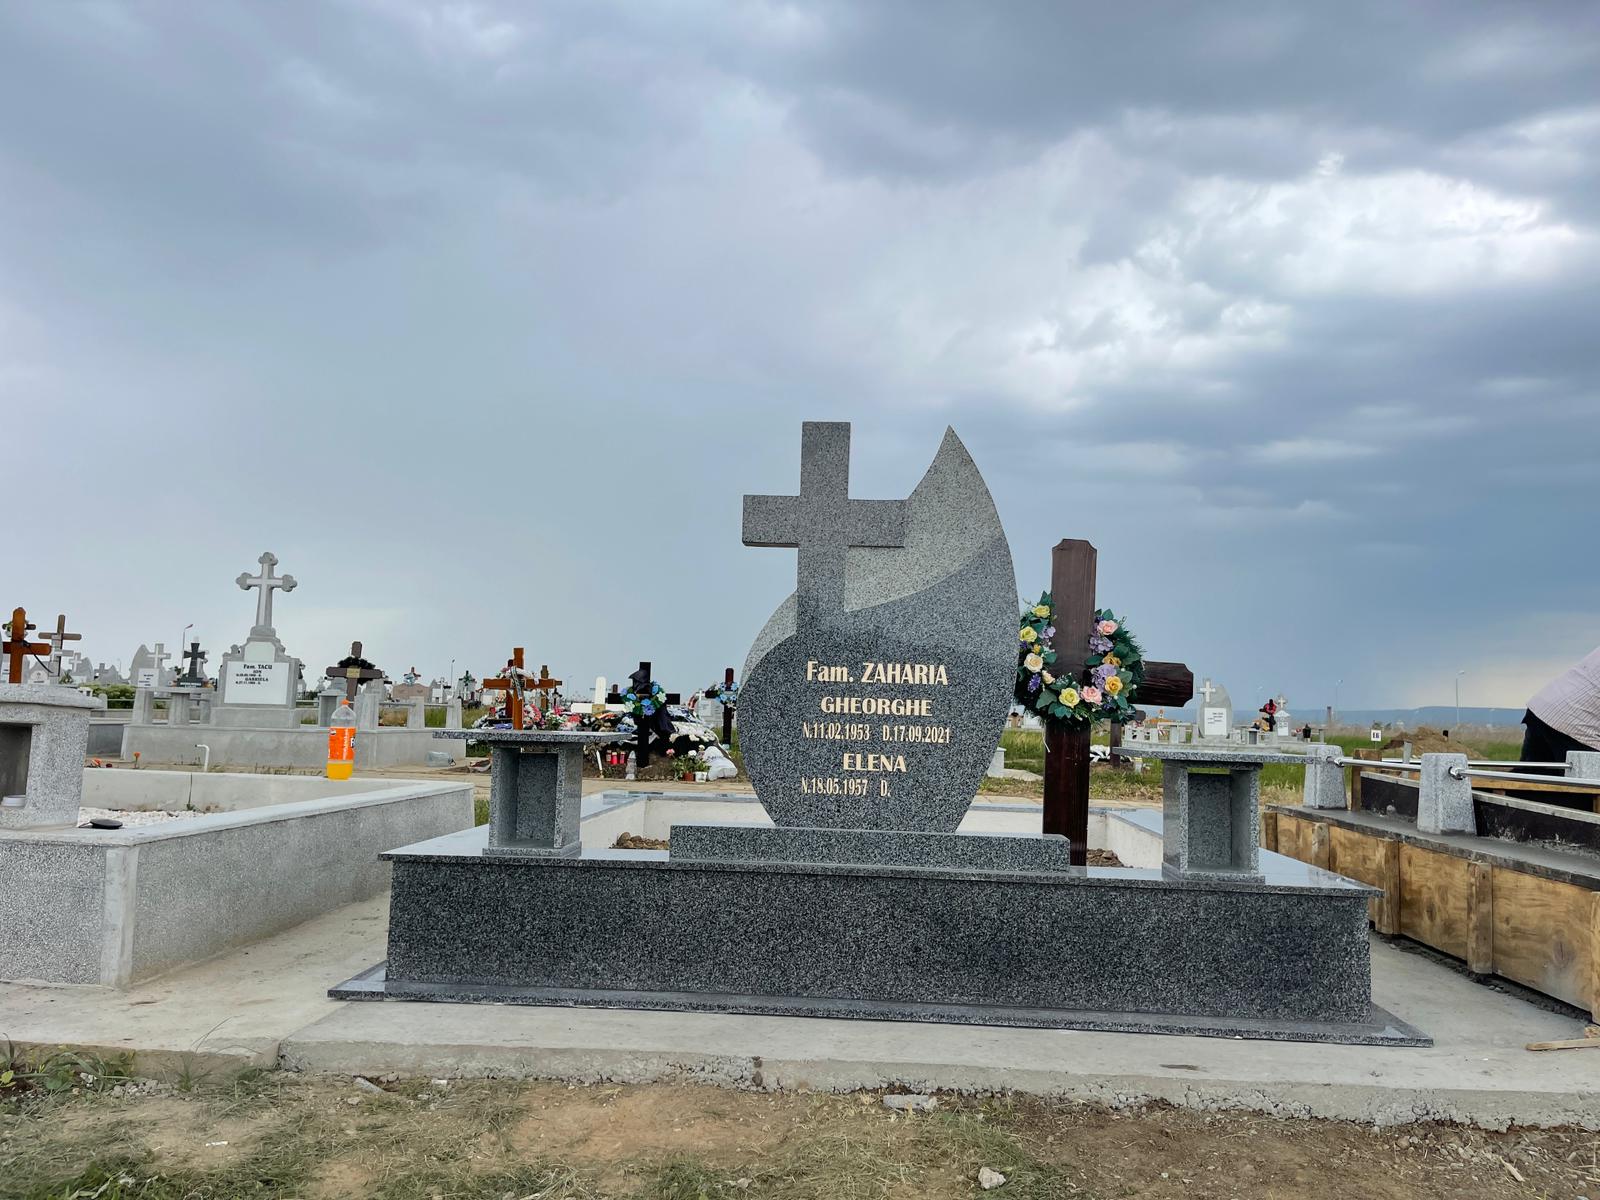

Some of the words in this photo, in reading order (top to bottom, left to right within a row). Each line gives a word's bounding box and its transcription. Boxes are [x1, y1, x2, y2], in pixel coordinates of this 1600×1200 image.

[806, 660, 854, 682] Fam.
[861, 662, 948, 685] ZAHARIA
[820, 696, 933, 717] GHEORGHE
[803, 721, 870, 741] N.11.02.1953
[882, 724, 951, 744] D.17.09.2021
[843, 753, 907, 772] ELENA
[801, 776, 868, 796] N.18.05.1957
[880, 779, 892, 797] D.
